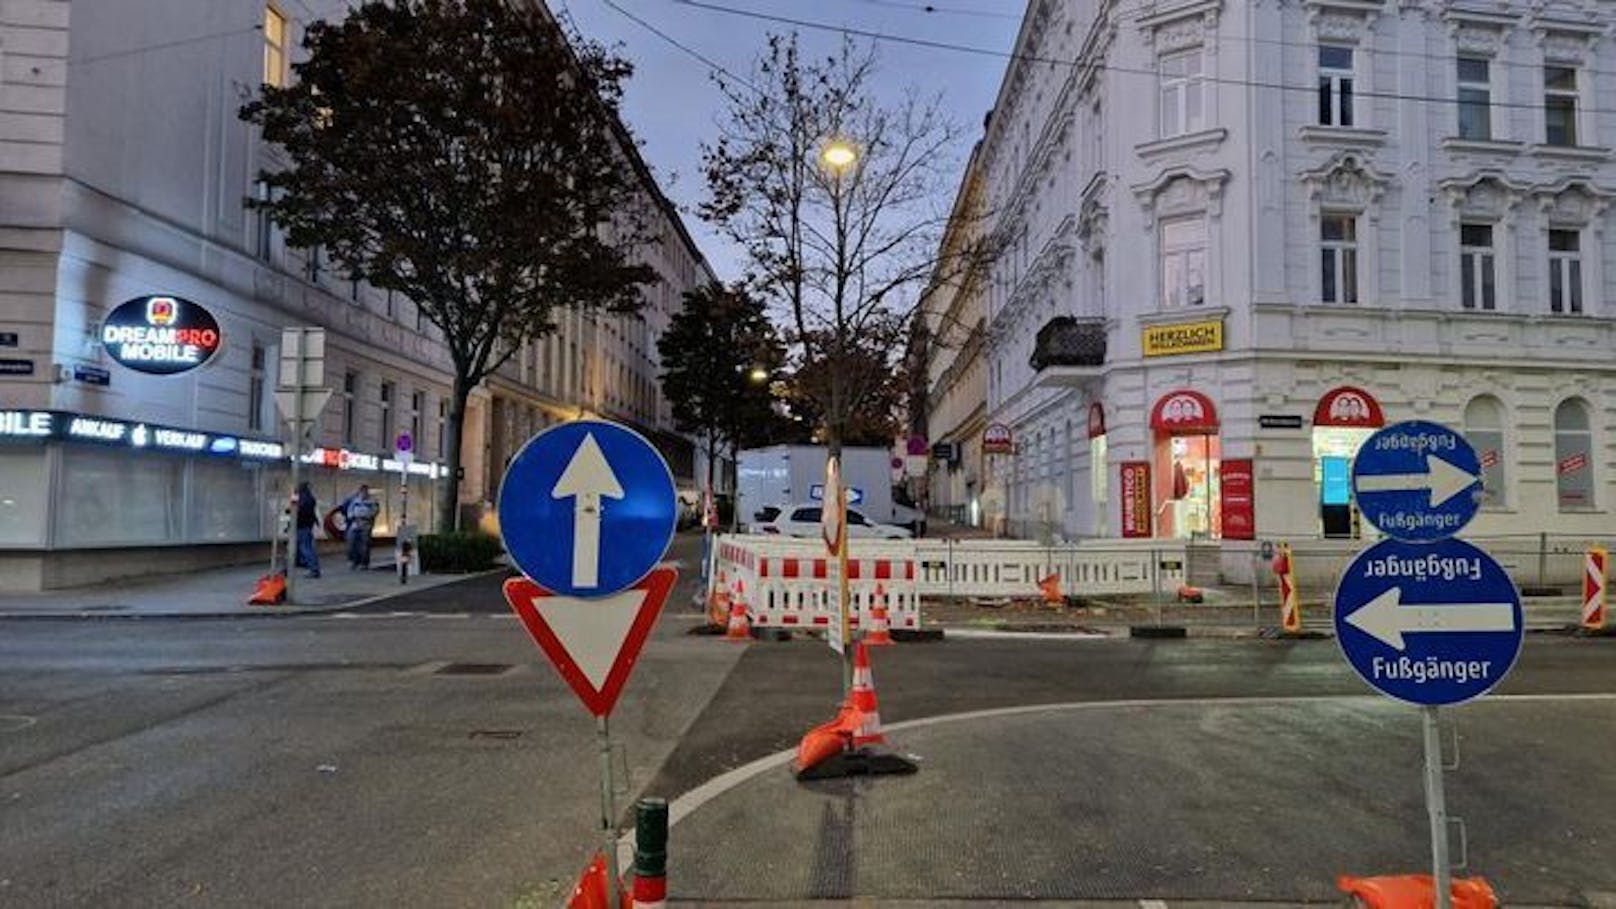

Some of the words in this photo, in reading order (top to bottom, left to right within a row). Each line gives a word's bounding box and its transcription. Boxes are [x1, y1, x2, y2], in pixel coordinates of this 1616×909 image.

[1148, 326, 1215, 343] HERZLICH
[121, 343, 200, 362] MOBILE
[70, 418, 125, 439] ANKAUF
[155, 429, 207, 449] VERKAUF
[1375, 432, 1456, 453] Fußgänger
[1379, 510, 1461, 531] Fußgänger
[1364, 553, 1482, 581] Fußgänger
[1373, 656, 1491, 684] Fußgänger
